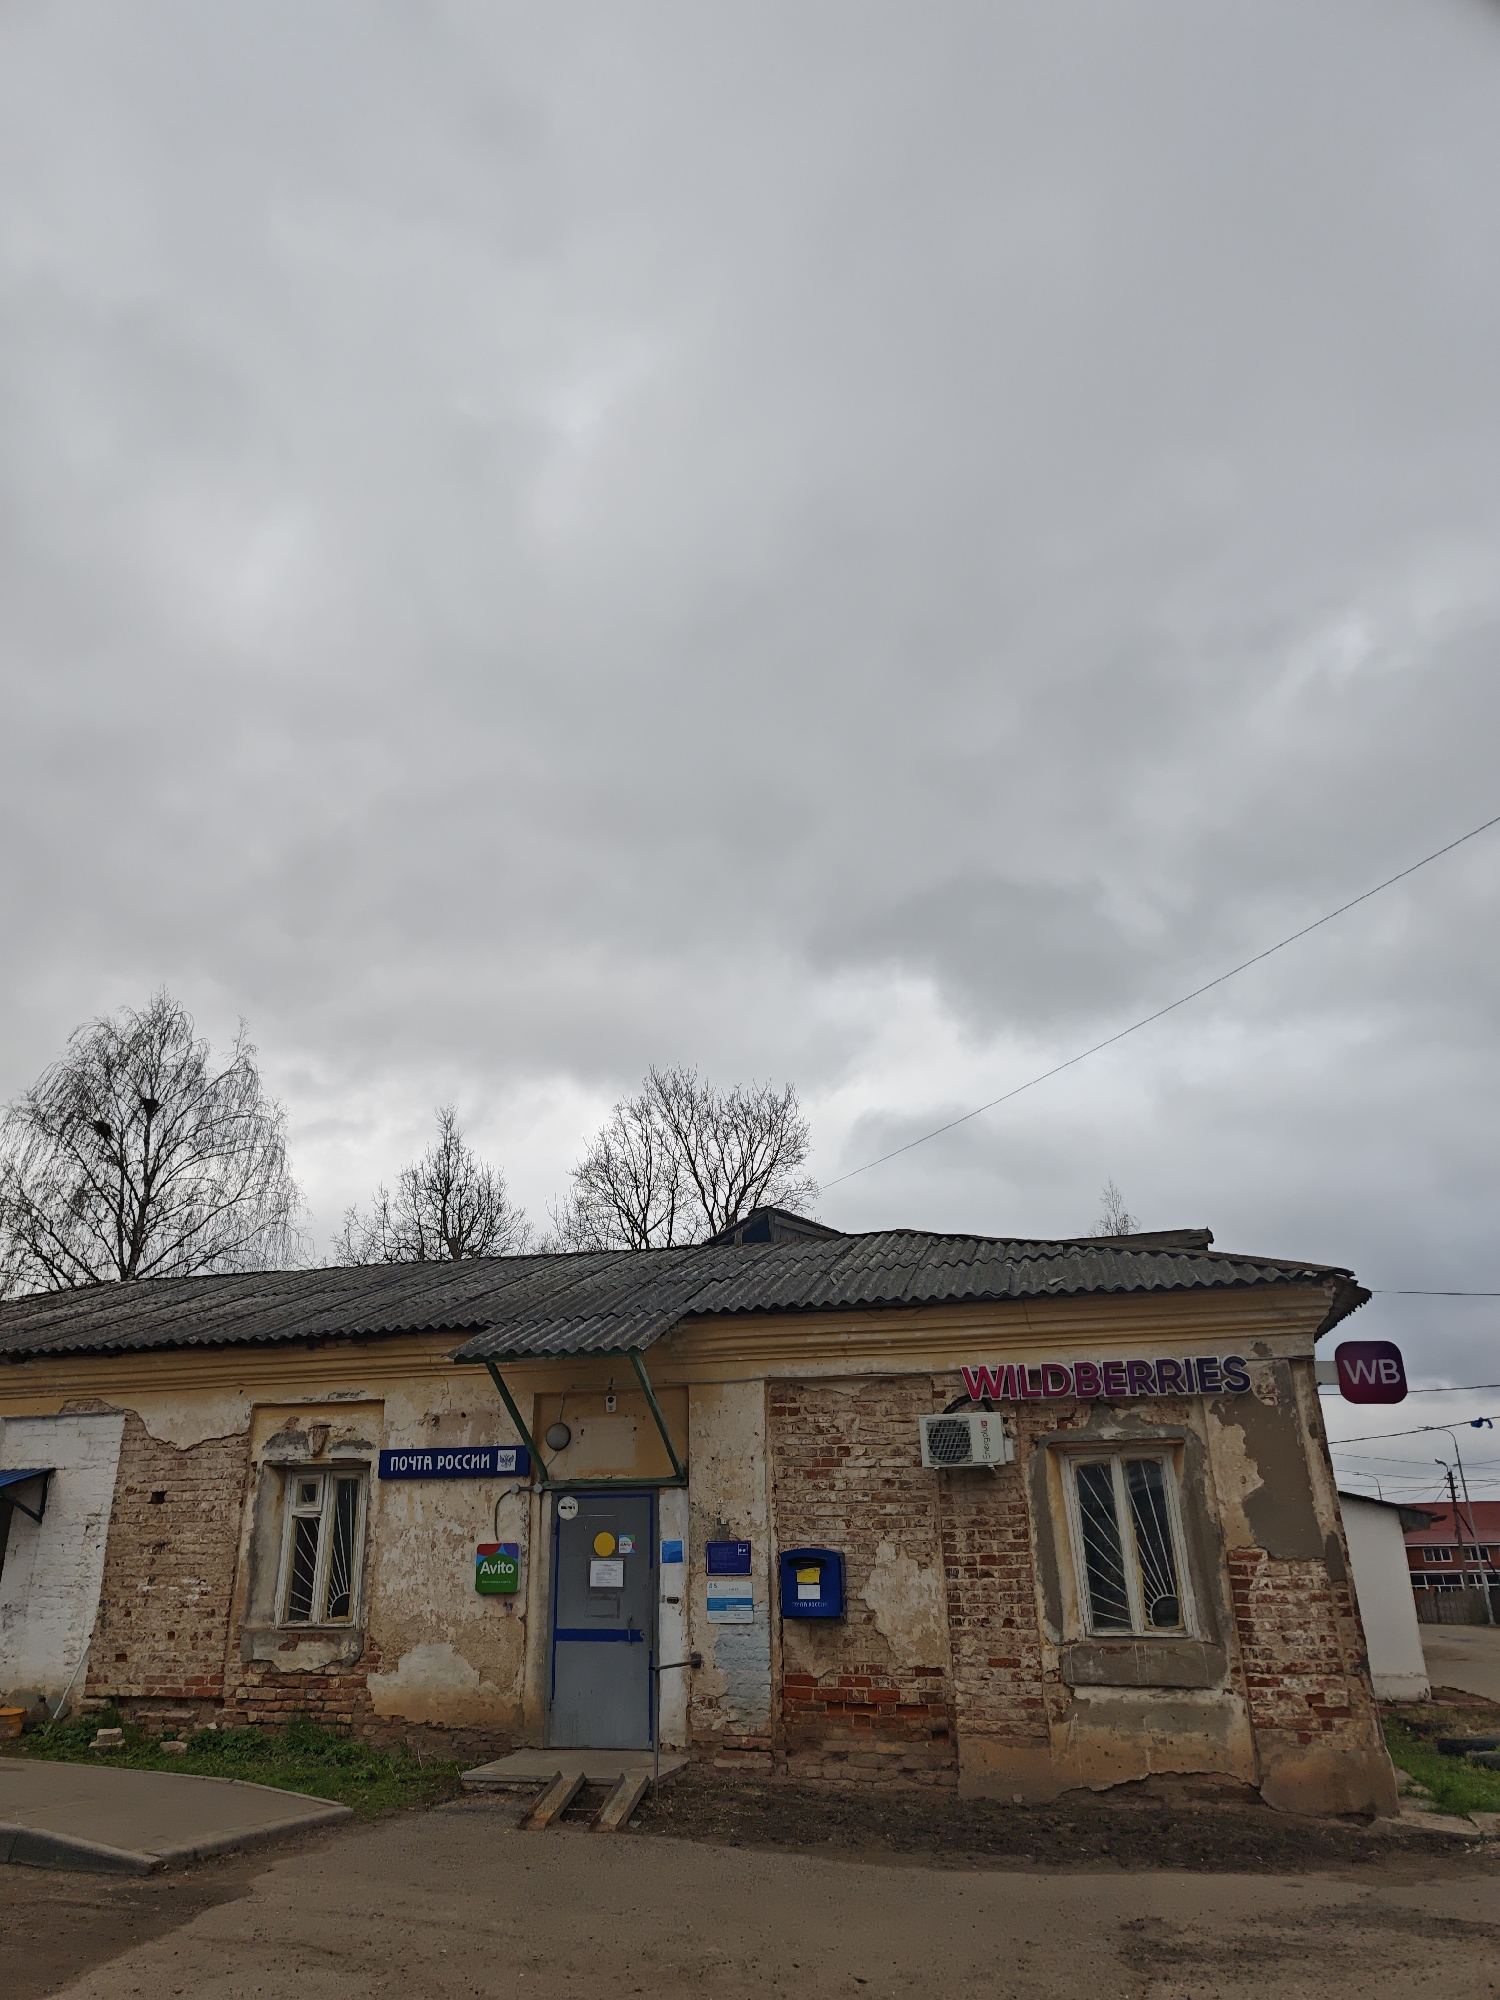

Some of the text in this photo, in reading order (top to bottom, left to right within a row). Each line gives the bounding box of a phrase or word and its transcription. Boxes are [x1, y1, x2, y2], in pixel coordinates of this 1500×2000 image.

[960, 1355, 1251, 1400] WILDBERRIES
[1343, 1359, 1400, 1384] WB
[981, 1420, 990, 1459] Energolux
[390, 1454, 490, 1471] ПОЧТА РОССИИ
[479, 1560, 514, 1574] Avito
